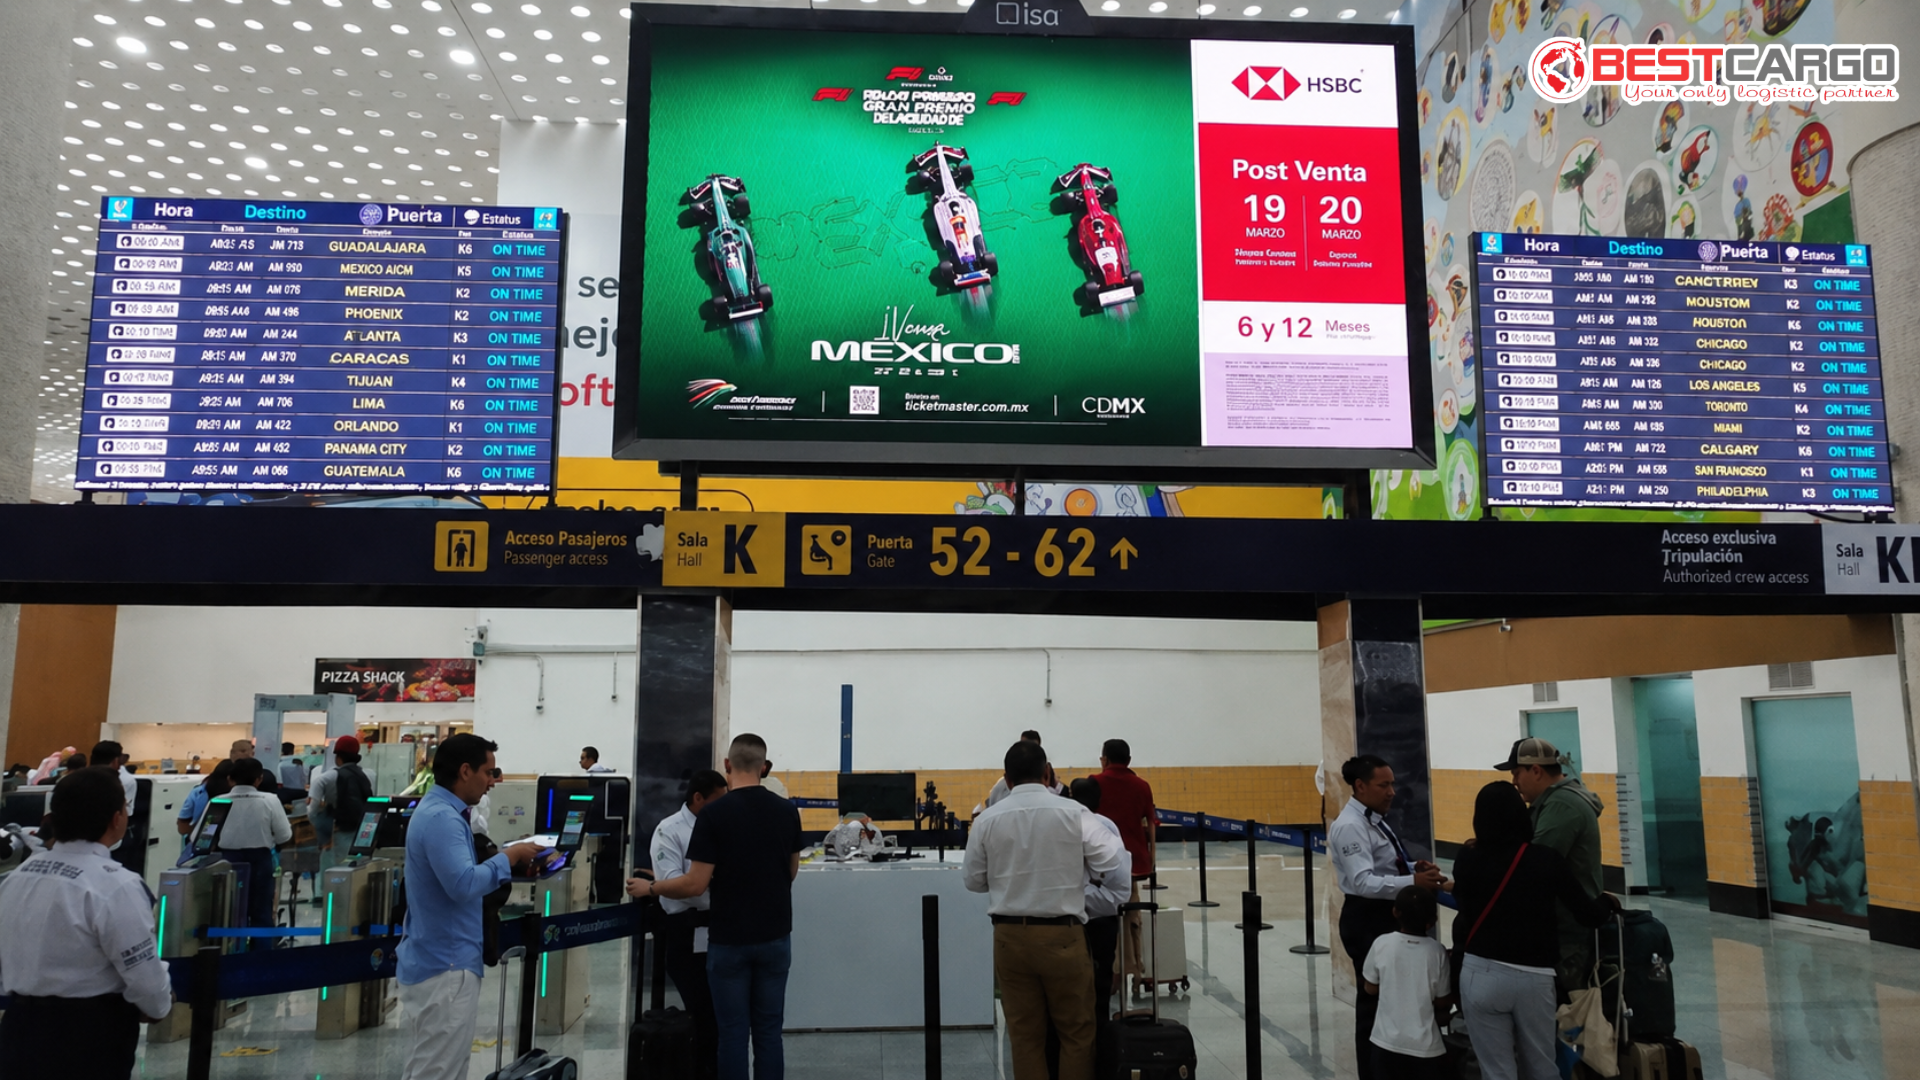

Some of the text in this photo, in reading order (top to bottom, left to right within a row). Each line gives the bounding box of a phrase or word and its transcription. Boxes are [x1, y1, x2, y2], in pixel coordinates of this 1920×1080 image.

[1307, 77, 1363, 93] HSBC
[863, 101, 975, 114] GRAN PREMIO
[1232, 158, 1367, 182] Post Venta
[154, 202, 521, 226] Hora Destino Puerta Estatus
[1243, 194, 1286, 223] 19
[1319, 195, 1363, 225] 20
[1245, 227, 1285, 239] MARZO
[1321, 228, 1362, 240] MARZO
[328, 241, 546, 257] GUADALAJARA K6 ON TIME
[1524, 238, 1560, 253] Hora
[1608, 240, 1664, 256] Destino
[1721, 243, 1769, 259] Puerta
[340, 263, 545, 279] MEXICO AICM K5 ON TIME
[344, 285, 544, 301] MERIDA K2 ON TIME
[1813, 279, 1831, 291] ON
[1834, 280, 1861, 292] TIME
[1815, 299, 1833, 311] ON
[1836, 300, 1863, 312] TIME
[344, 308, 543, 323] PHOENIX K2 ON TIME
[1237, 316, 1370, 342] 6 y 12 Meses
[1817, 320, 1835, 332] ON
[1837, 321, 1864, 333] TIME
[453, 332, 469, 344] K3
[487, 332, 508, 344] ON
[511, 333, 542, 345] TIME
[1695, 338, 1749, 349] CHICAGO
[1818, 341, 1836, 352] ON
[1839, 342, 1866, 353] TIME
[329, 352, 541, 367] CARACAS K1 ON TIME
[1698, 359, 1748, 371] CHICAGO
[1820, 361, 1838, 373] ON
[1841, 362, 1868, 374] TIME
[346, 375, 540, 390] TIJUAN K4 ON TIME
[1688, 380, 1711, 391] LOS
[1711, 381, 1762, 392] ANGELES
[1822, 382, 1840, 394] ON
[1843, 383, 1870, 395] TIME
[352, 397, 539, 412] LIMA K6 ON TIME
[904, 400, 1029, 414] ticketmaster.com.mx
[1081, 396, 1147, 414] CDMX
[1704, 401, 1749, 413] TORONTO
[1824, 403, 1842, 416] ON
[1845, 404, 1872, 417] TIME
[333, 420, 538, 435] ORLANDO K1 ON TIME
[1712, 423, 1744, 434] MIAMI
[1826, 424, 1844, 436] ON
[1847, 425, 1874, 437] TIME
[324, 443, 537, 457] PANAMA CITY K2 ON TIME
[1699, 444, 1760, 456] CALGARY
[1827, 445, 1846, 457] ON
[1848, 446, 1876, 458] TIME
[323, 465, 536, 480] GUATEMALA K6 ON TIME
[1694, 466, 1715, 476] SAN
[1714, 466, 1768, 477] FRANCISCO
[1829, 466, 1848, 478] ON
[1850, 467, 1878, 479] TIME
[1696, 486, 1770, 497] PHILADELPHIA
[1831, 487, 1850, 499] ON
[1852, 488, 1880, 500] TIME
[505, 530, 628, 550] Acceso Pasajeros
[677, 532, 708, 547] Sala
[867, 534, 913, 550] Puerta
[1661, 529, 1777, 545] Acceso exclusiva
[723, 524, 758, 574] K
[929, 526, 1096, 577] 52 - 62
[1661, 547, 1743, 566] Tripulación
[1835, 543, 1864, 558] Sala
[504, 551, 609, 569] Passenger access
[677, 552, 702, 567] Hall
[867, 554, 895, 568] Gate
[1663, 568, 1810, 584] Authorized crew access
[1837, 562, 1860, 576] Hall
[320, 670, 406, 683] PIZZA SHACK
